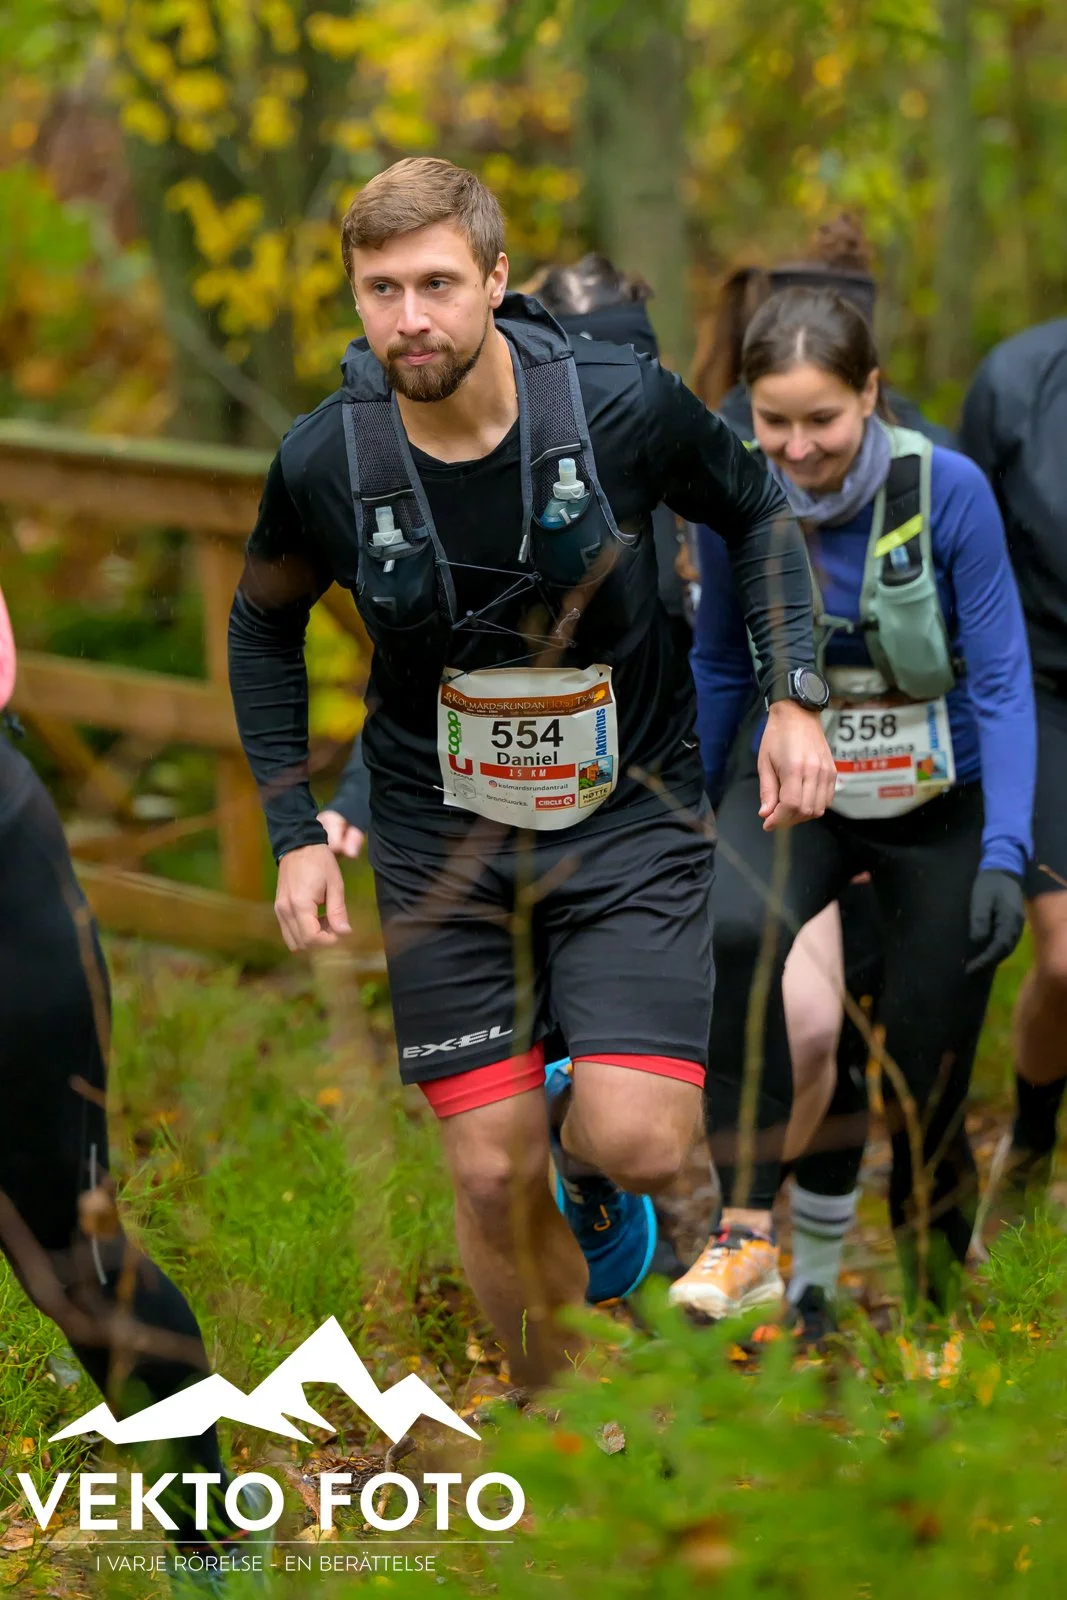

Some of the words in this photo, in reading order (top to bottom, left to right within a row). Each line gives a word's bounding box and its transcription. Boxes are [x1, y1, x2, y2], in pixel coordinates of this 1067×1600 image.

[447, 710, 461, 755] coop
[491, 719, 564, 749] 554
[595, 708, 607, 756] Aktivitus
[838, 714, 897, 742] 558
[497, 751, 558, 766] Daniel
[509, 769, 522, 777] 15
[531, 769, 547, 777] KM
[403, 1026, 513, 1058] EXEL
